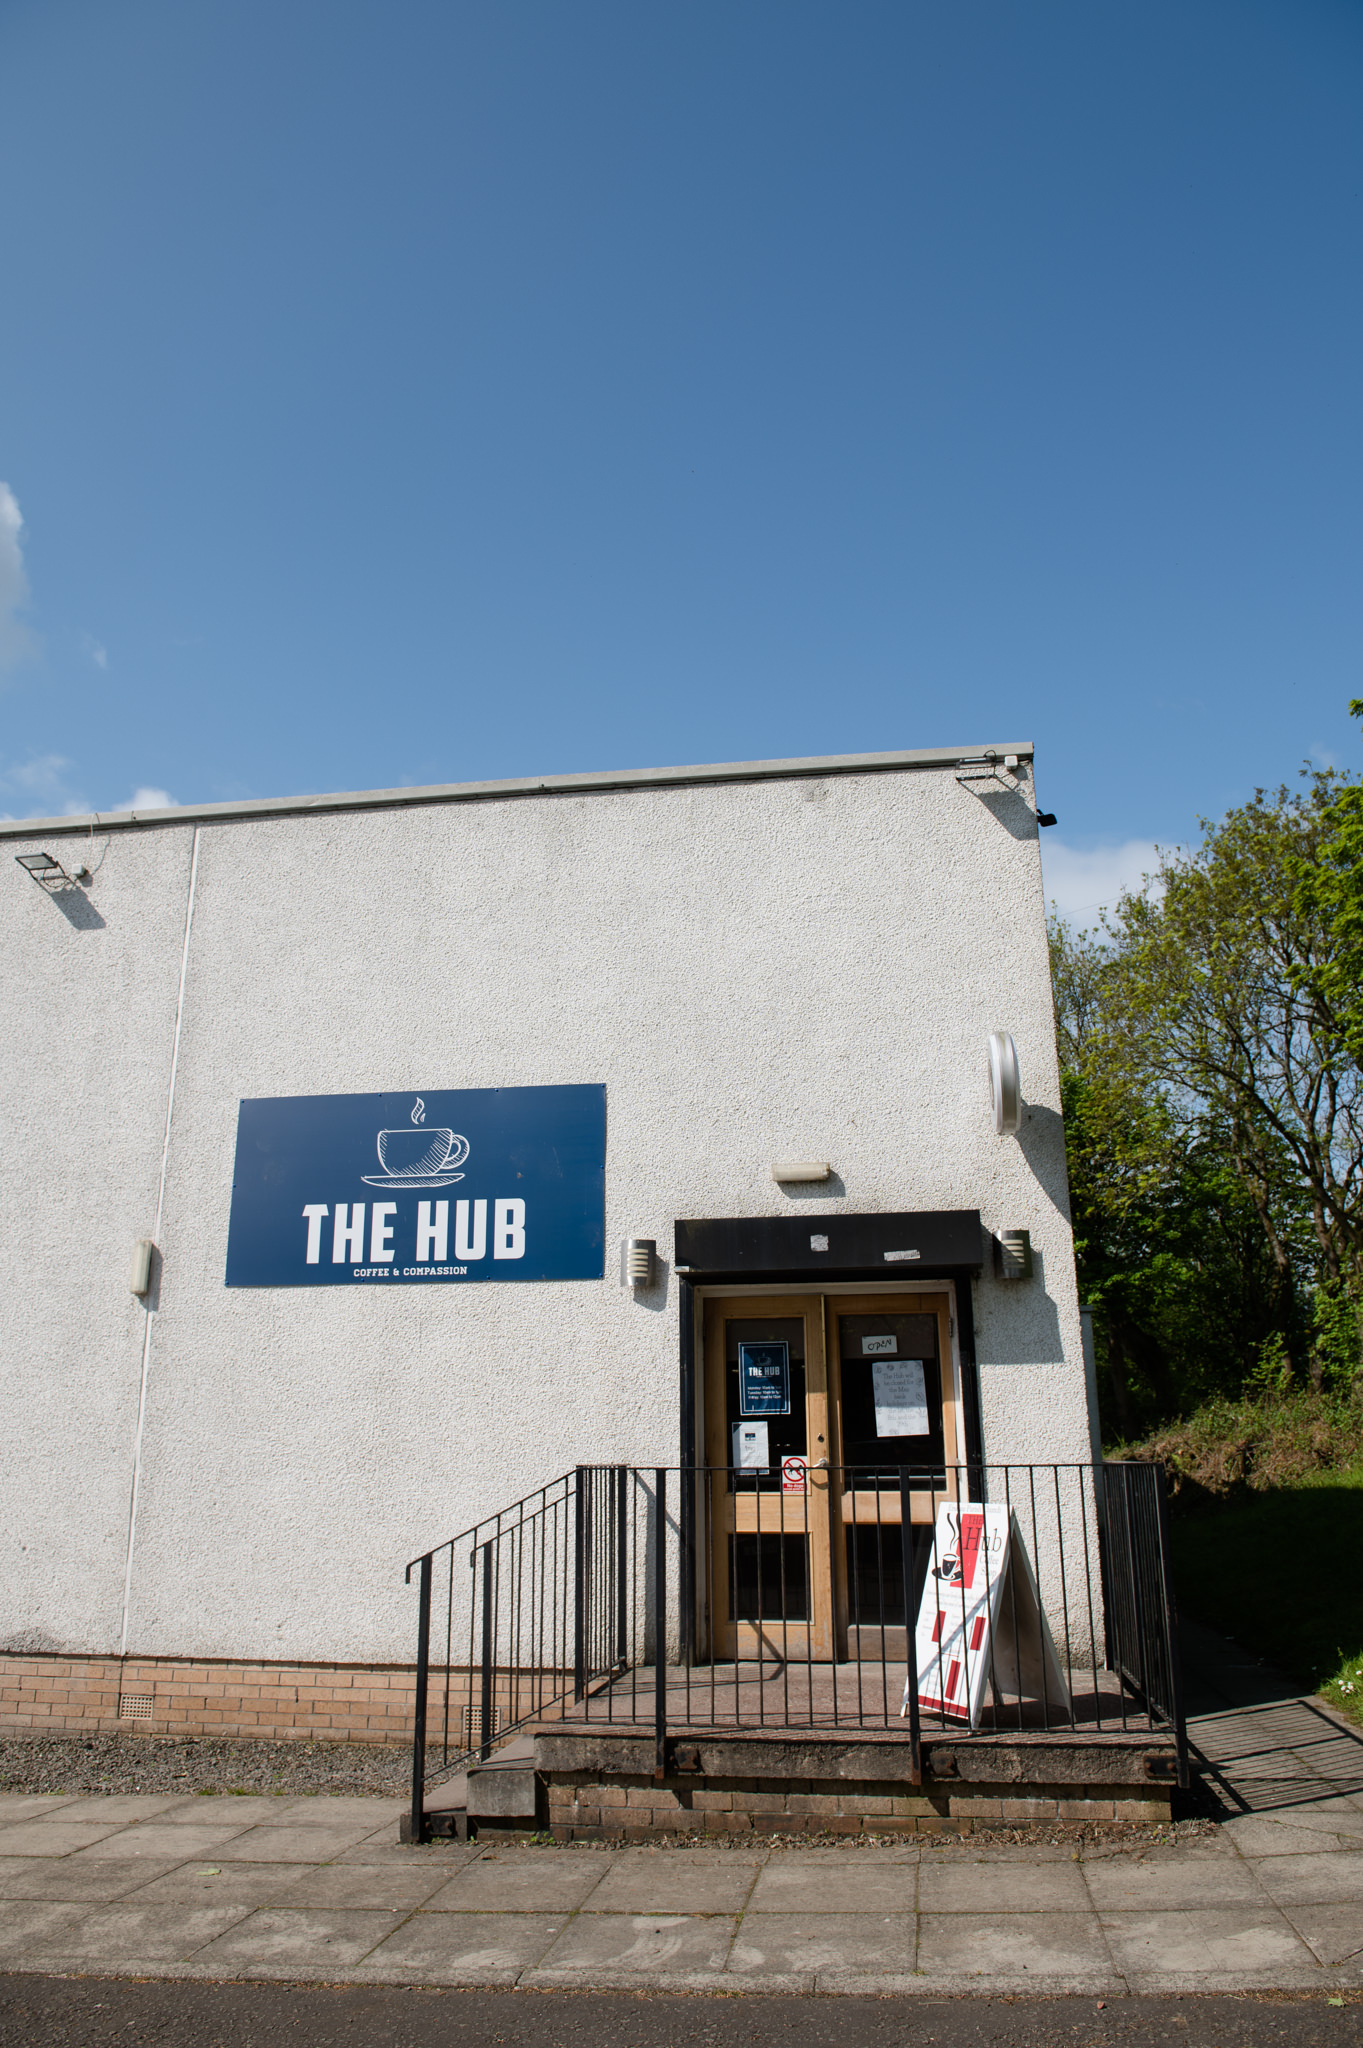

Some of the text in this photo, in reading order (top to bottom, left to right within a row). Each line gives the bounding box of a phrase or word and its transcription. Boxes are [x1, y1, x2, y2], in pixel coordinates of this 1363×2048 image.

[302, 1198, 526, 1264] THE HUB
[353, 1266, 468, 1278] COFFEE & COMPASSION
[748, 1366, 780, 1376] THE HUB
[968, 1515, 984, 1525] THE
[962, 1527, 1002, 1552] Hub
